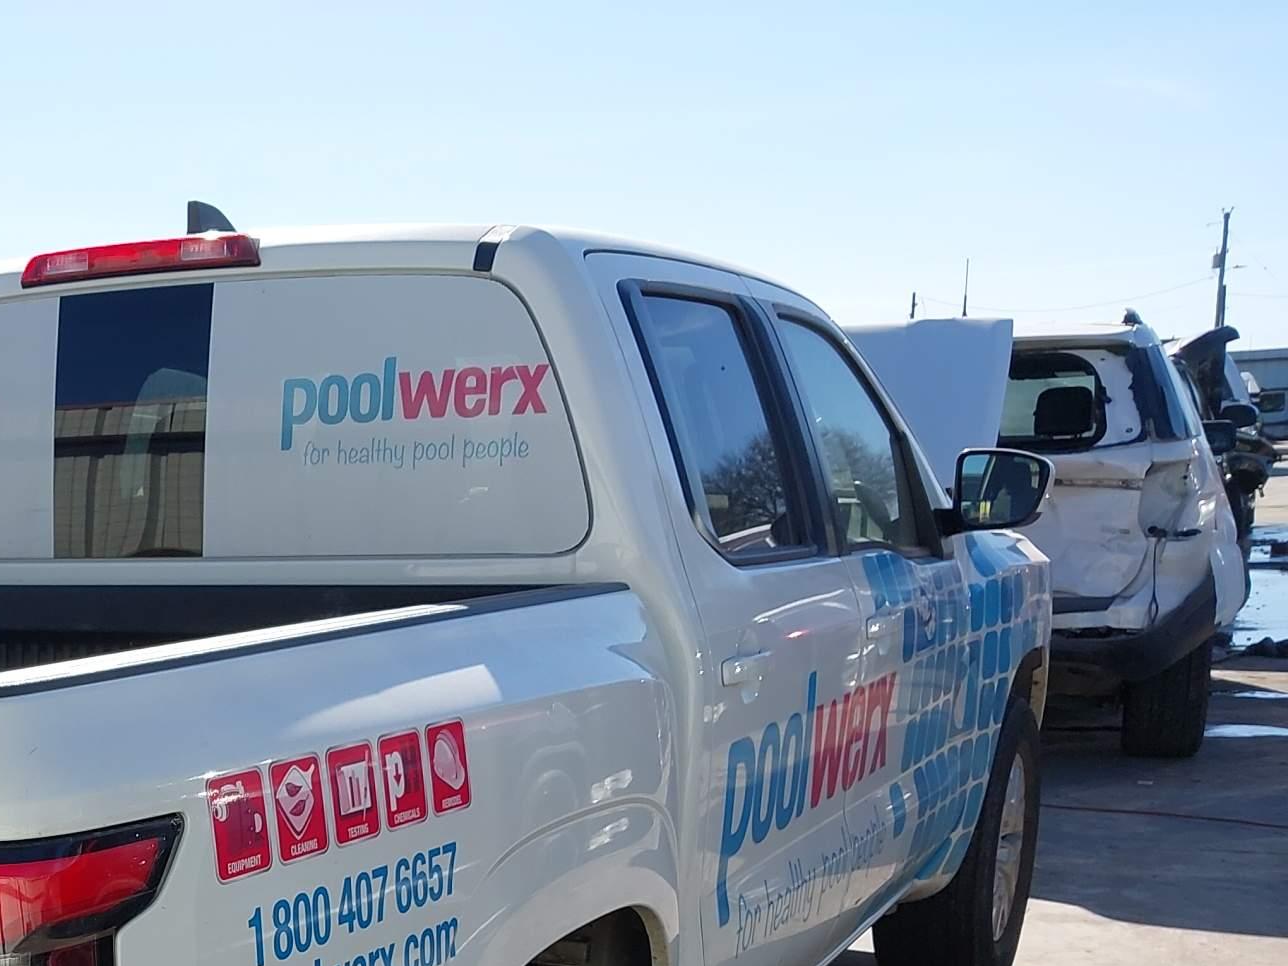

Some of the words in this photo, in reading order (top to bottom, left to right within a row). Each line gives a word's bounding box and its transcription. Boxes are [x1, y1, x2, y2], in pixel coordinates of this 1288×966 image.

[280, 356, 549, 451] poolwerx
[303, 441, 330, 466] for
[337, 437, 405, 469] healthy
[413, 433, 455, 470] pool
[462, 431, 529, 467] people
[347, 824, 369, 839] TESTING
[717, 671, 896, 928] poolwerx
[227, 854, 262, 875] EQUIPMENT
[290, 838, 318, 857] CLEANING
[272, 886, 332, 961] 800
[338, 865, 389, 934] 407
[395, 841, 457, 914] 6657
[735, 894, 761, 958] for
[764, 858, 816, 937] healthy
